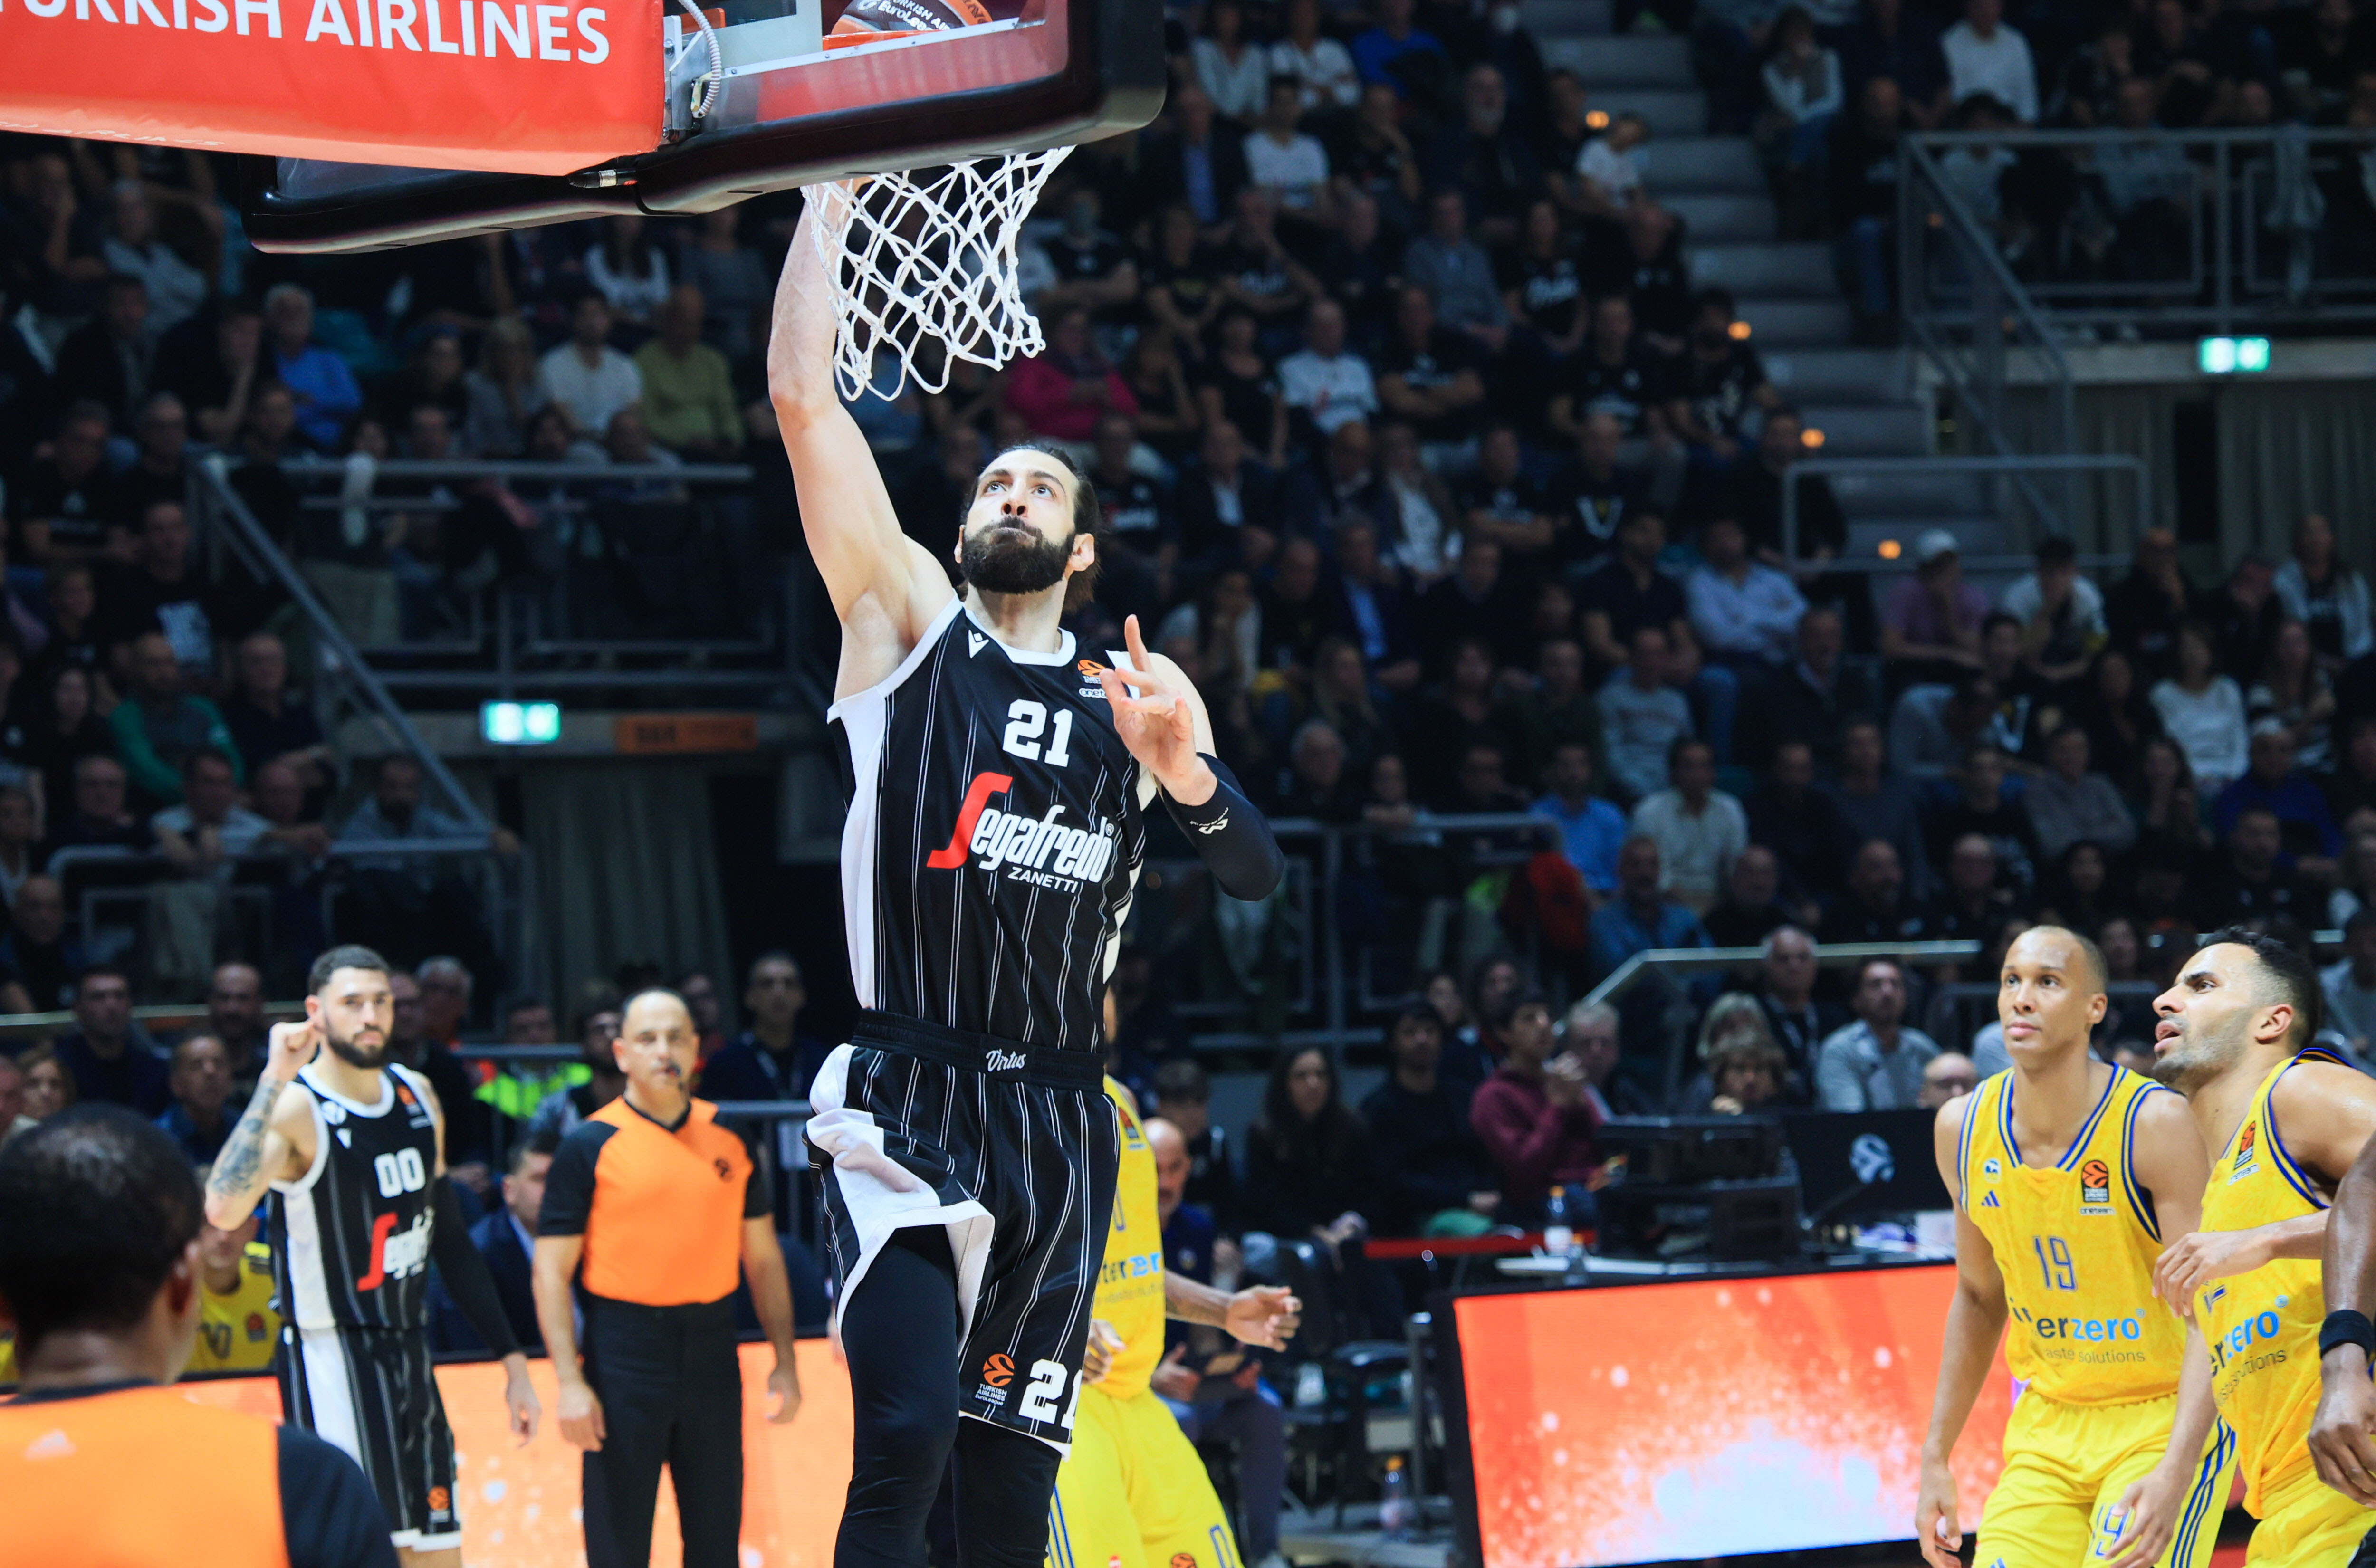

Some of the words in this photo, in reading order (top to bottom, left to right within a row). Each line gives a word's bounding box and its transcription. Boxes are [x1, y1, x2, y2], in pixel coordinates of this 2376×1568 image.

[305, 0, 609, 64] AIRLINES
[1002, 698, 1073, 767] 21
[927, 772, 1112, 883] Segafredo
[1008, 866, 1079, 893] ZANETTI
[986, 1048, 1026, 1072] Virtus
[374, 1147, 426, 1198] 00
[2033, 1235, 2077, 1291] 19
[2045, 1348, 2075, 1361] aste
[2078, 1351, 2146, 1364] solutions
[975, 1393, 1004, 1406] EuroLeague
[977, 1389, 1006, 1401] AIRLINES
[979, 1383, 1007, 1396] TURKISH
[1018, 1358, 1083, 1430] 21
